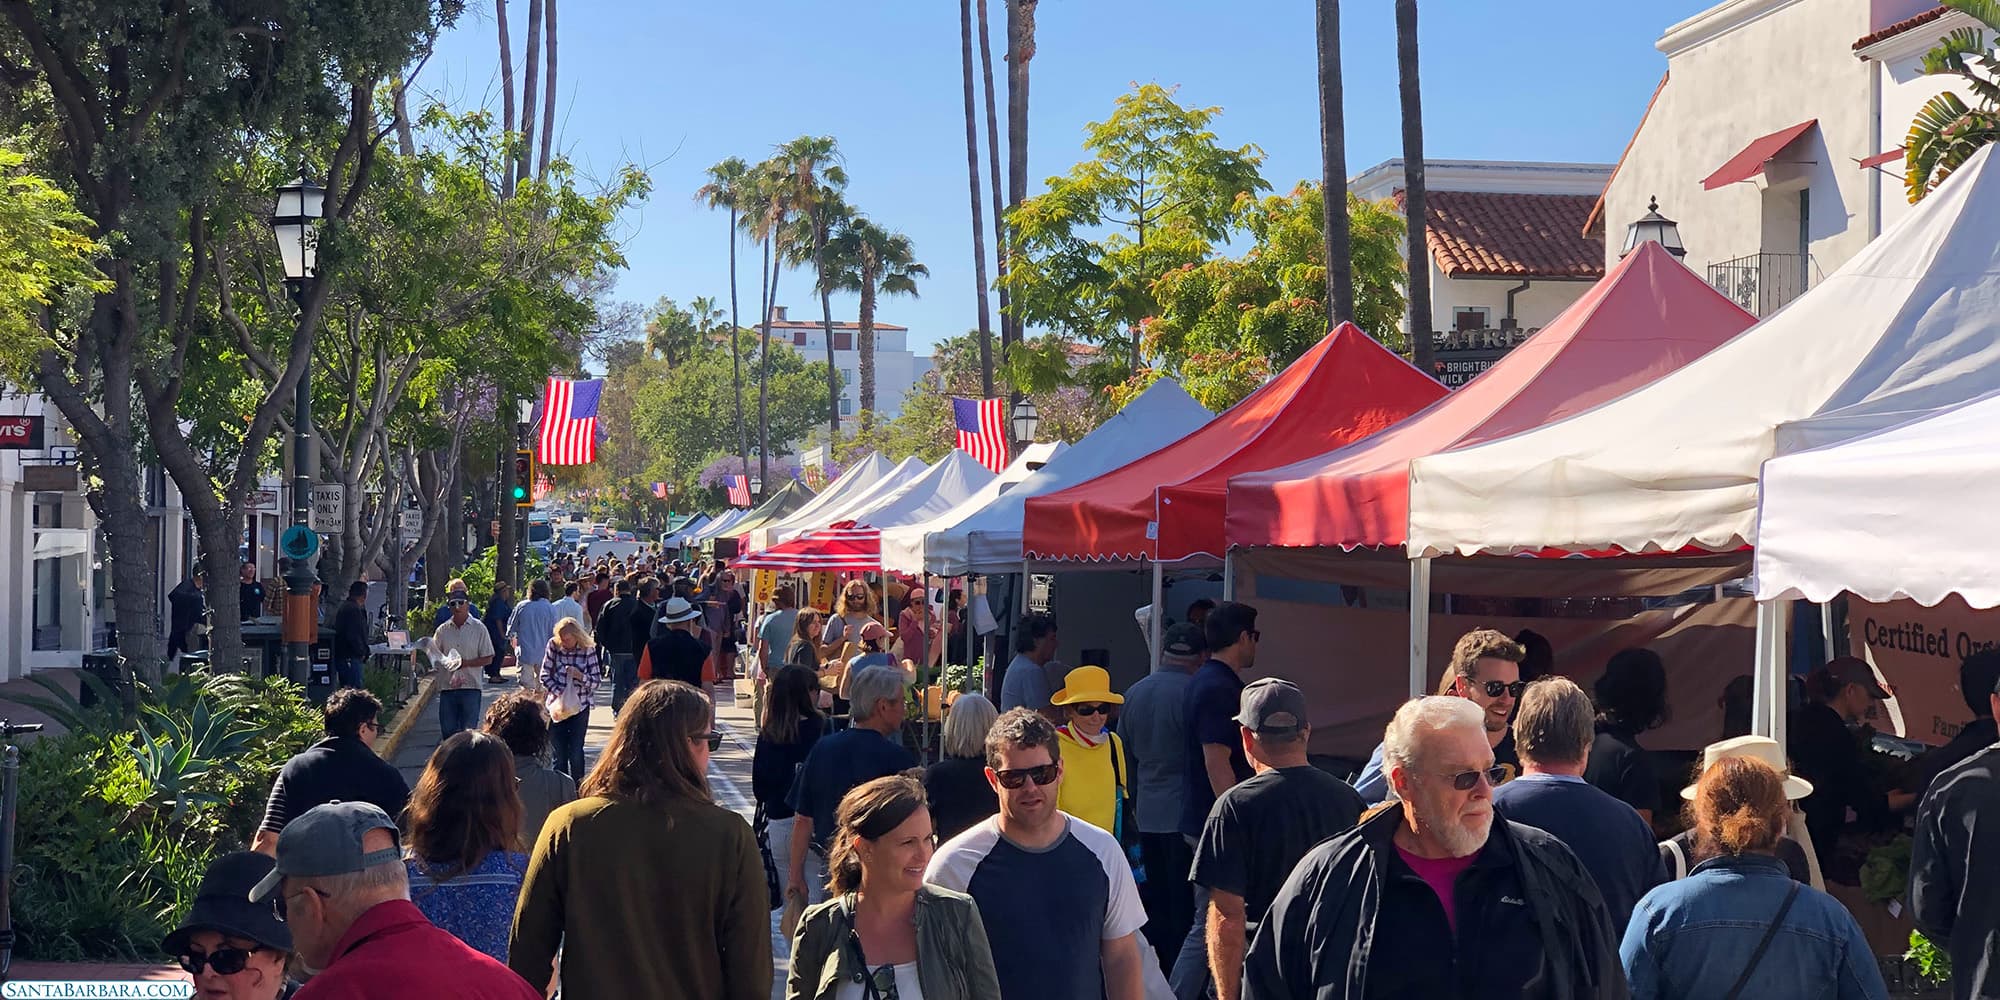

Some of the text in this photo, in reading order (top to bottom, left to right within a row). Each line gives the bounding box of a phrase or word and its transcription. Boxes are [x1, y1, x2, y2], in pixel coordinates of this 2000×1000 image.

[1447, 361, 1498, 372] BRIGHTBU
[1439, 374, 1464, 384] WICK
[316, 491, 340, 501] TAXIS
[317, 504, 338, 514] ONLY
[1864, 617, 1950, 658] Certified
